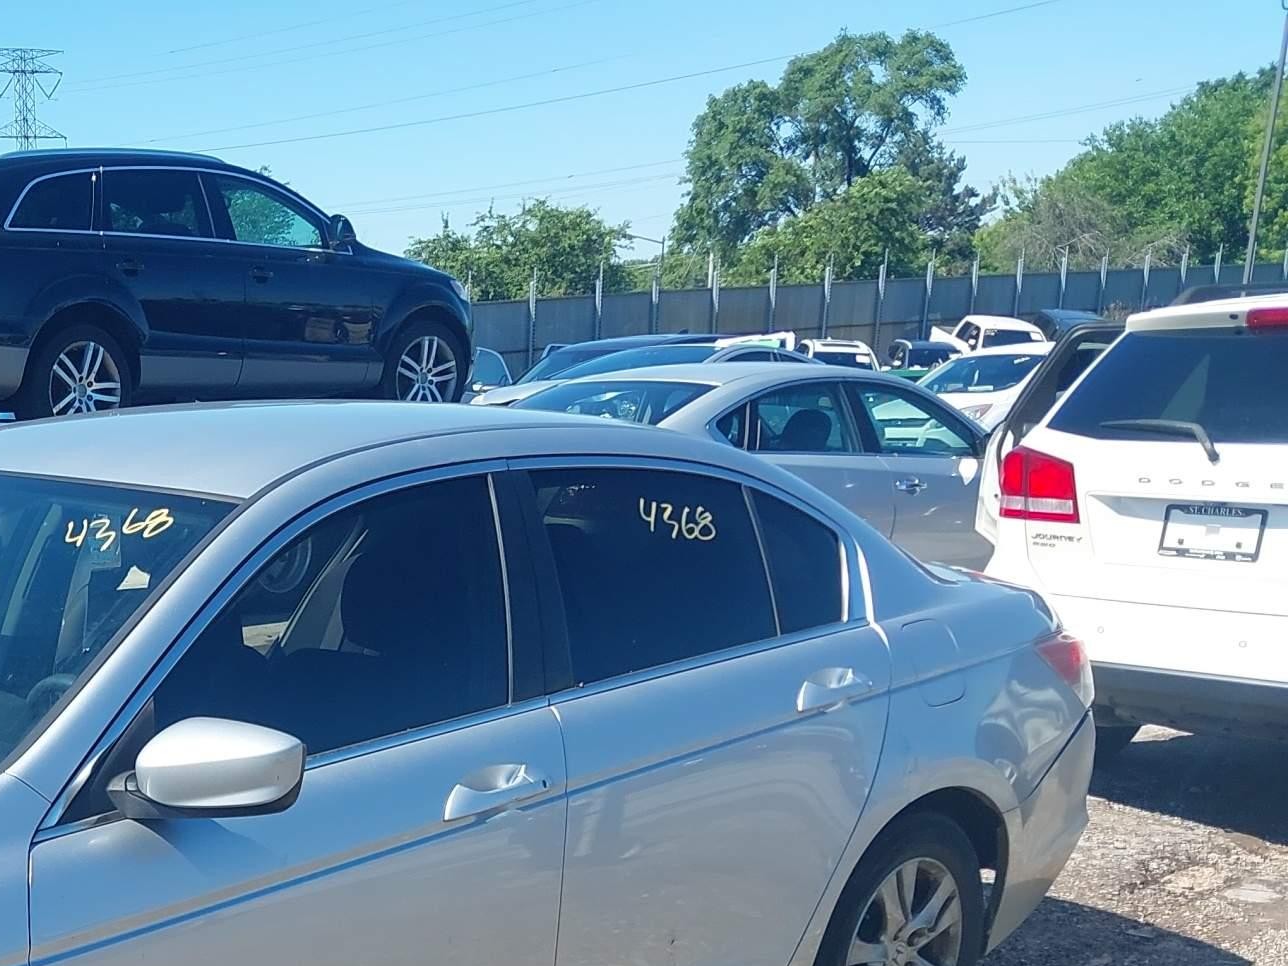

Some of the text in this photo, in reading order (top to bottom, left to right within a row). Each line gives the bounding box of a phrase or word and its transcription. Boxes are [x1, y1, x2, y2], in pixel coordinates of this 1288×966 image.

[1138, 476, 1285, 490] DODGE
[639, 497, 716, 540] 4368
[1202, 507, 1242, 516] CHARLES
[64, 507, 174, 551] 4368
[1031, 533, 1083, 543] JOURNEY
